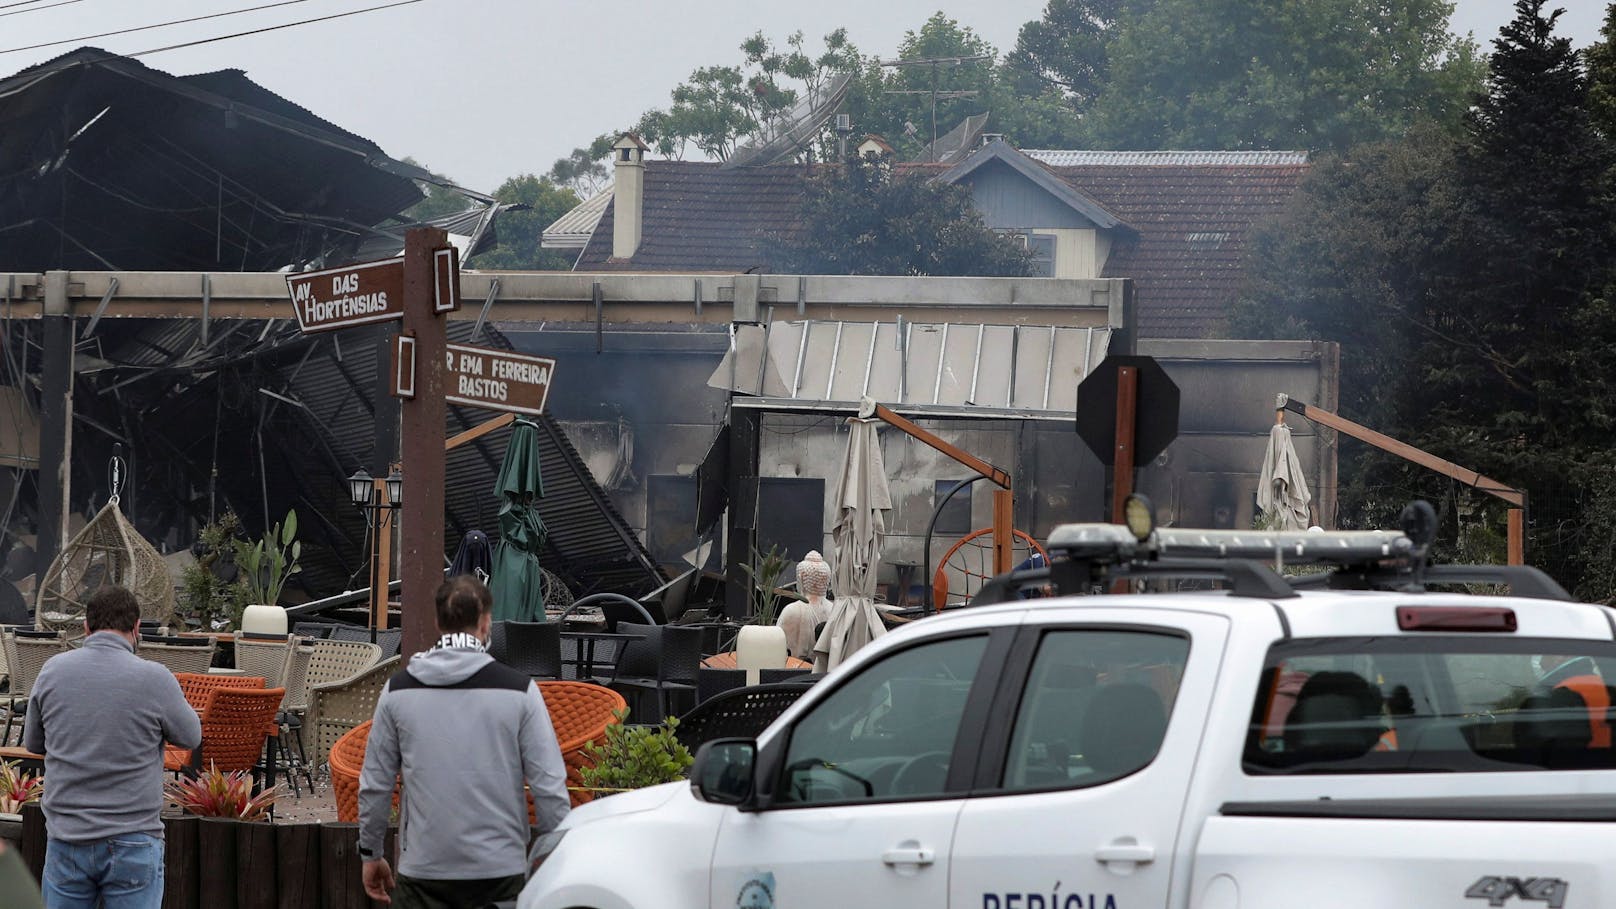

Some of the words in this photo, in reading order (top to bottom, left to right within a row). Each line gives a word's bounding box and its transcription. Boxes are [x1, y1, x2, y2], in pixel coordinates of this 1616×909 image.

[296, 282, 315, 301] AV.
[332, 273, 359, 296] DAS
[304, 291, 388, 323] HORTÊNSIAS
[460, 354, 483, 376] EMA
[491, 359, 547, 385] FERREIRA
[458, 375, 508, 402] BASTOS
